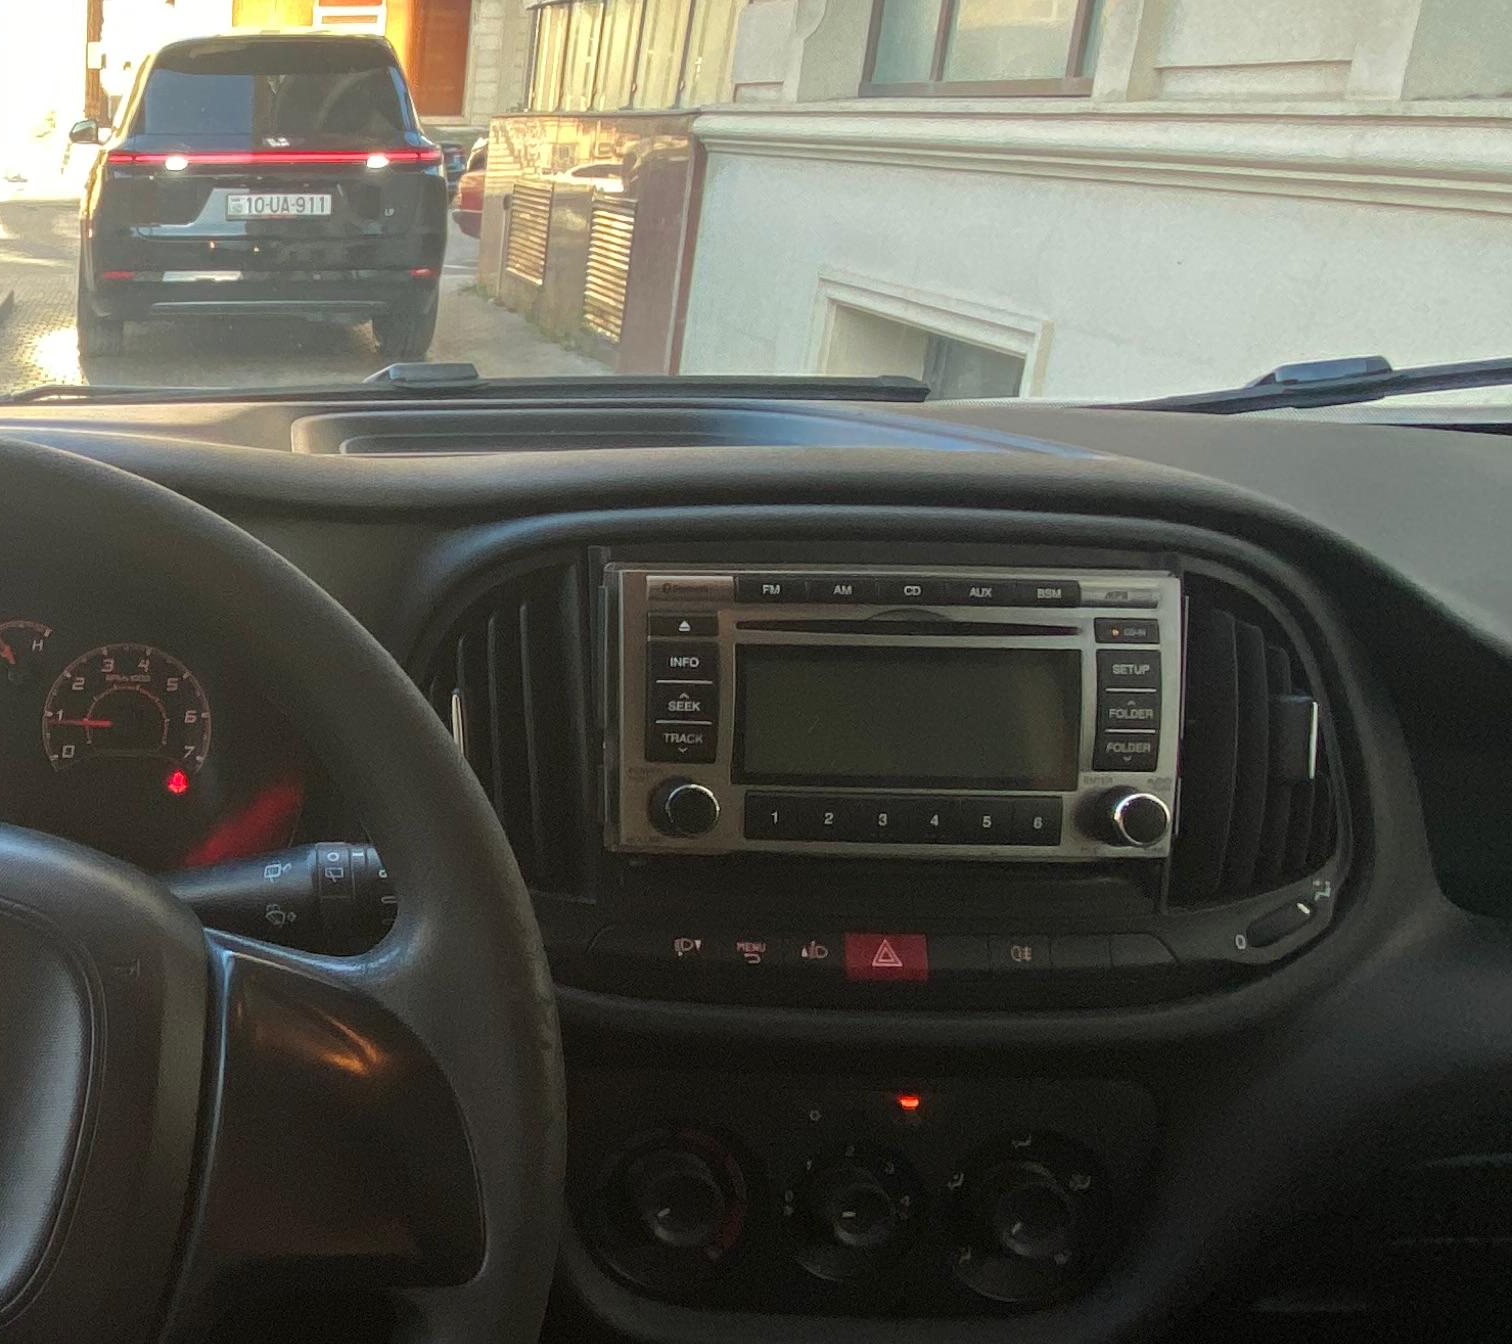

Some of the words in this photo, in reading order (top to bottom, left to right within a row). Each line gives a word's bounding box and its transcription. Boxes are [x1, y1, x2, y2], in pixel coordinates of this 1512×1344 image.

[245, 196, 326, 214] 10-UA-911
[762, 584, 781, 596] FM
[832, 584, 853, 596] AM
[903, 585, 922, 596] CD
[968, 587, 993, 599] AUX
[1036, 588, 1062, 599] BSM
[31, 639, 44, 652] H
[101, 658, 115, 673] 3
[138, 658, 151, 673] 4
[669, 656, 700, 668] INFO
[1112, 663, 1150, 675] SETUP
[71, 676, 85, 691] 2
[166, 677, 179, 692] 5
[667, 700, 701, 712] SEEK
[56, 709, 65, 721] 1
[184, 709, 198, 724] 6
[1108, 708, 1154, 720] FOLDER
[663, 732, 704, 744] TRACK
[183, 745, 196, 759] 7
[1105, 742, 1151, 753] FOLDER
[770, 811, 779, 824] 1
[823, 812, 835, 825] 2
[878, 813, 888, 825] 3
[929, 814, 940, 827] 4
[981, 815, 992, 828] 5
[1033, 816, 1044, 829] 6
[736, 941, 767, 953] MENU
